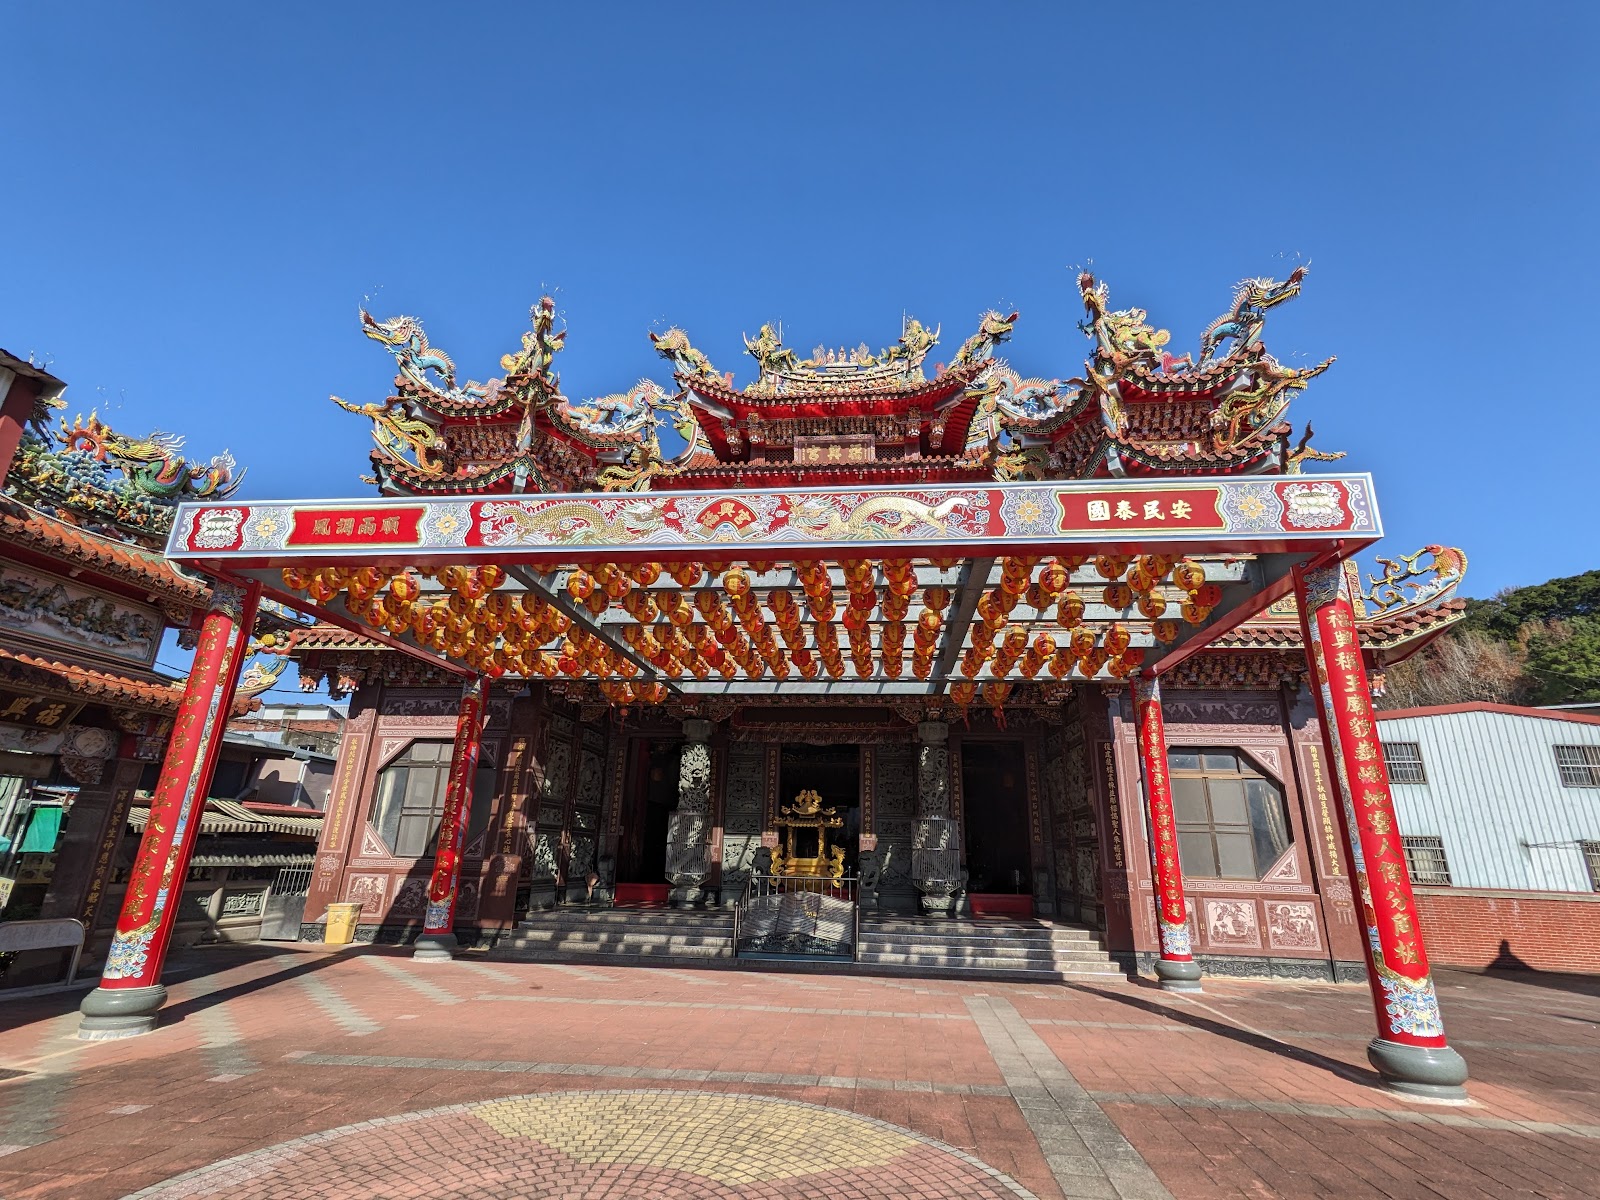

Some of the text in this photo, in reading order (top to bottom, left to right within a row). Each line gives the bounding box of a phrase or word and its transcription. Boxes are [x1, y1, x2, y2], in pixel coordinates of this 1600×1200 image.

[701, 502, 751, 527] 福興宮
[1087, 500, 1192, 521] 國泰民安
[311, 516, 400, 536] 風調雨順
